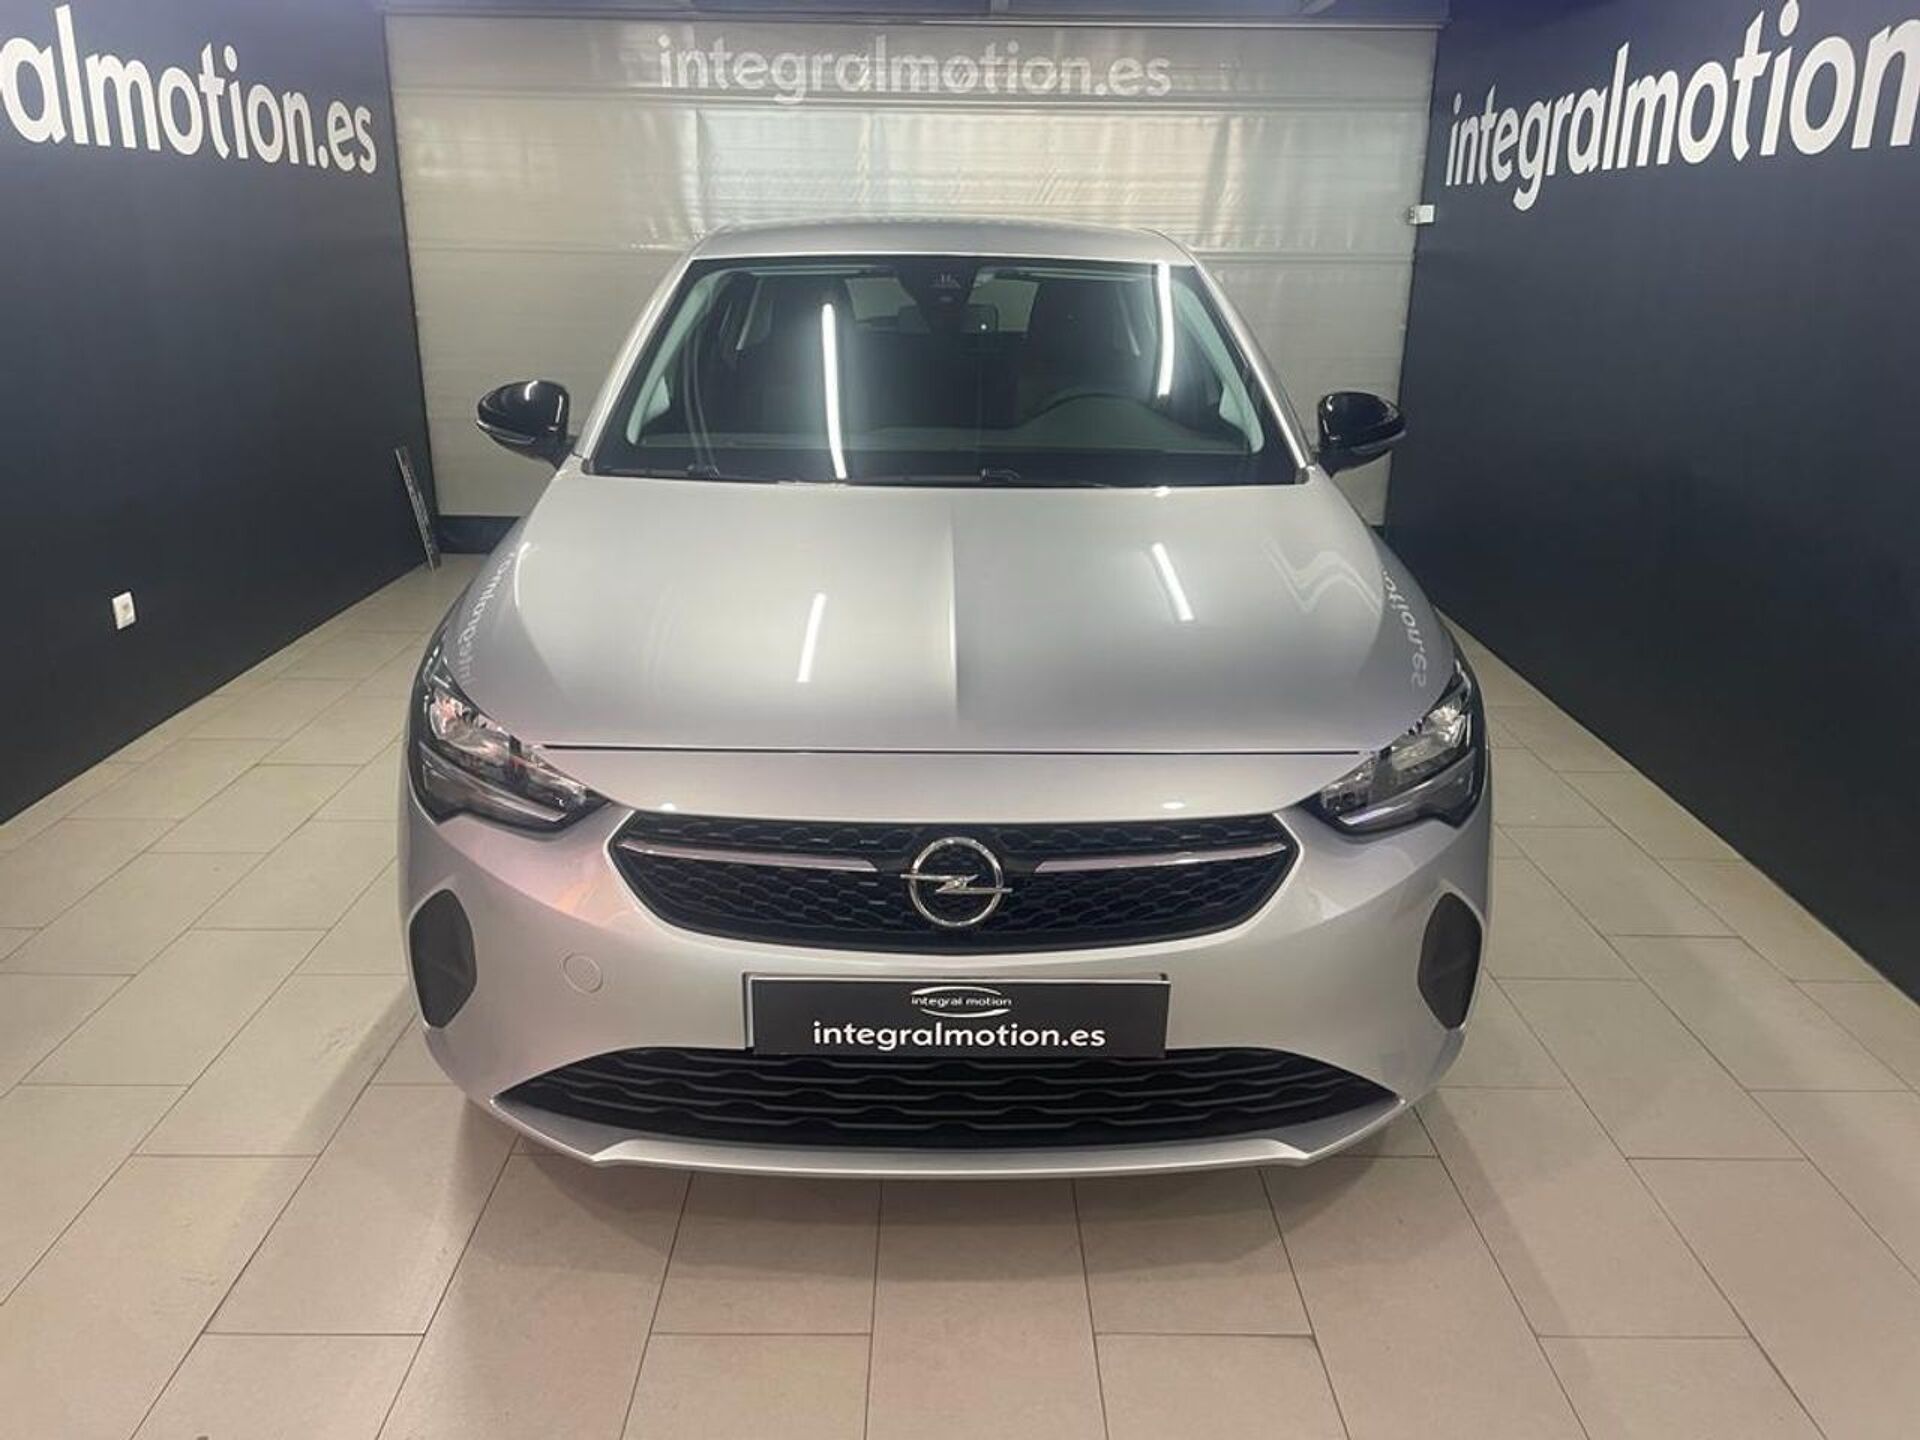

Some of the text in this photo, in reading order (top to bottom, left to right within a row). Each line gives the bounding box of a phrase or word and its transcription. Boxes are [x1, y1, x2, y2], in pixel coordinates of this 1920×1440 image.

[0, 4, 377, 174] almotion.es
[658, 34, 1173, 104] integralmotion.es
[1445, 0, 1920, 211] integralmotion
[812, 1020, 1106, 1051] integralmotion.es
[911, 996, 1012, 1008] integral motion
